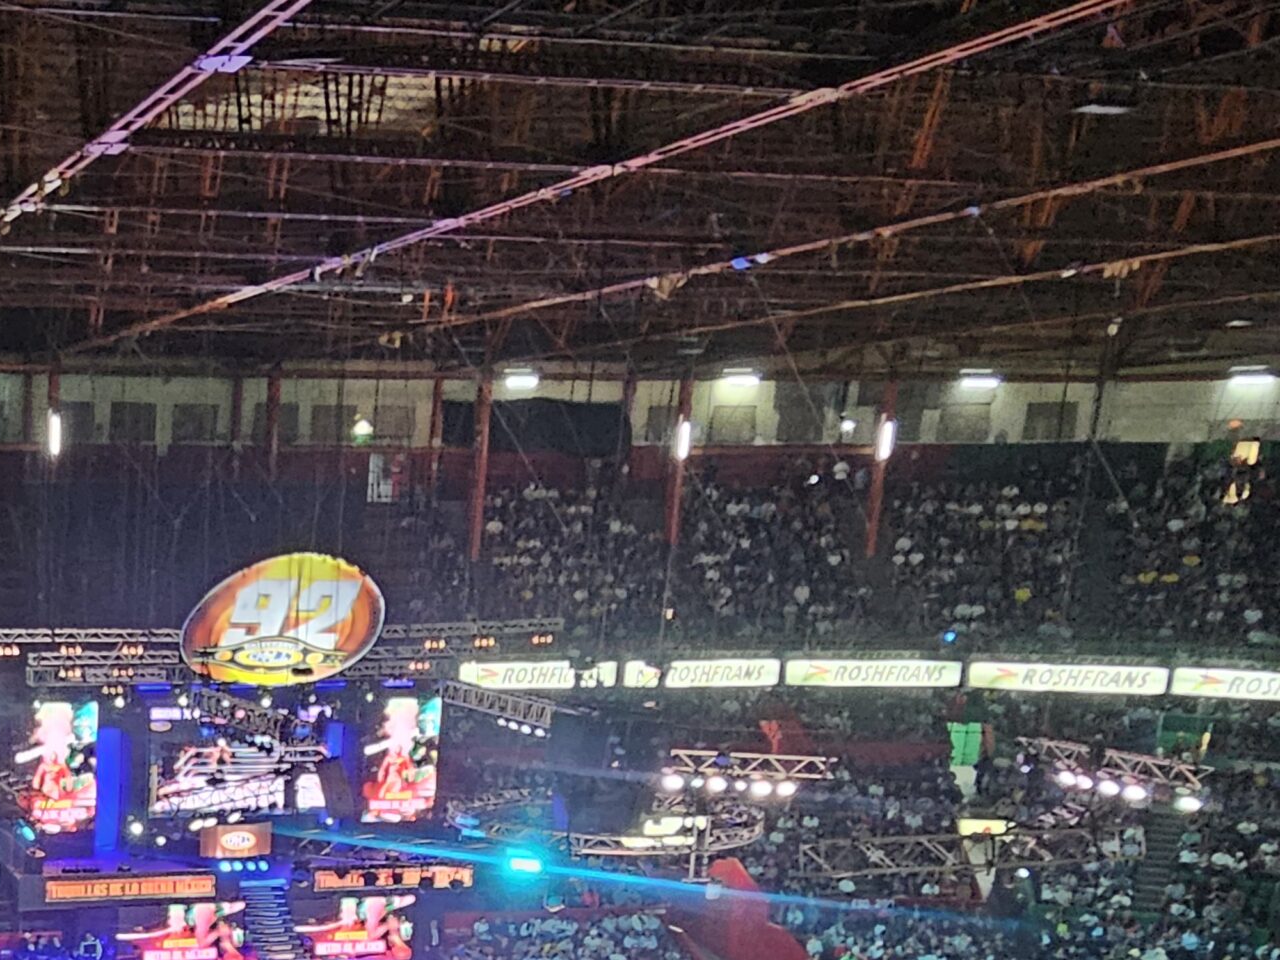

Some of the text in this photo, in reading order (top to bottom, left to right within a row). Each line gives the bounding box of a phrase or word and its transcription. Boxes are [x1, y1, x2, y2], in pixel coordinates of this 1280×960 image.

[222, 579, 363, 650] 92
[834, 664, 947, 682] ROSHFRANS
[1021, 667, 1151, 689] ROSHFRANS
